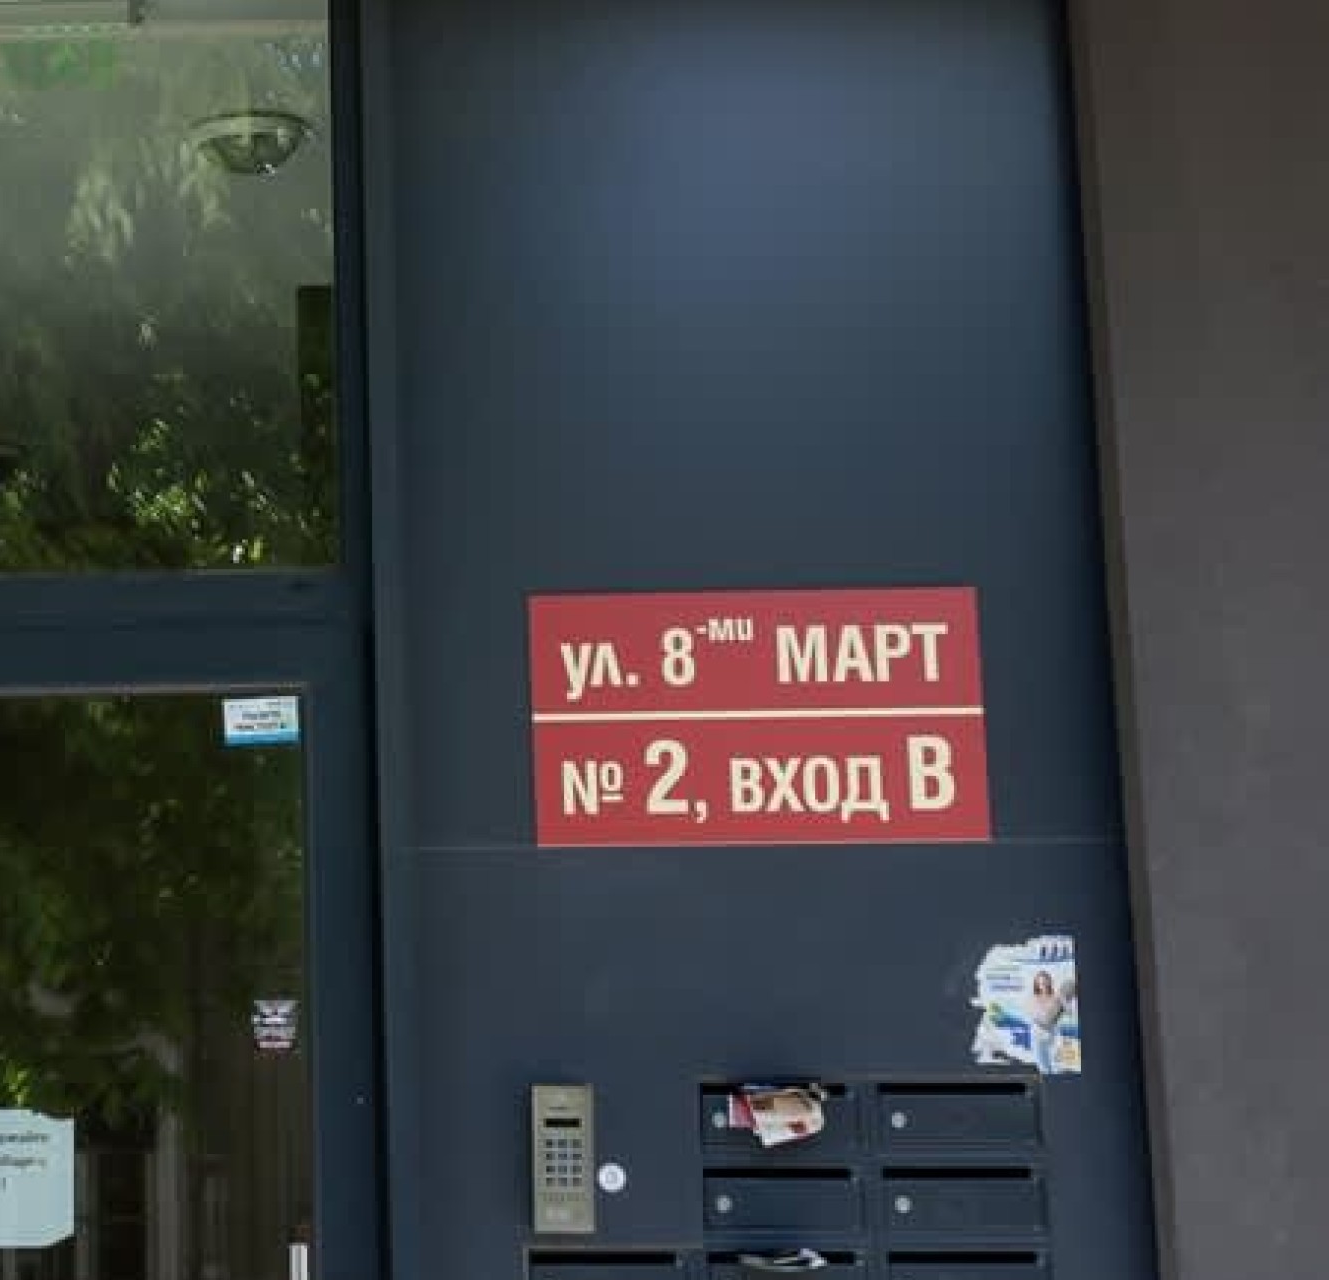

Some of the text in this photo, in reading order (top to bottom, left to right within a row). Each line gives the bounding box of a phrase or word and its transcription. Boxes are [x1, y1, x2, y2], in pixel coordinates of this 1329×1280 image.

[560, 641, 640, 701] ул.
[776, 622, 949, 684] МАРТ
[561, 759, 624, 815] №
[644, 739, 709, 823] 2,
[906, 734, 957, 812] В
